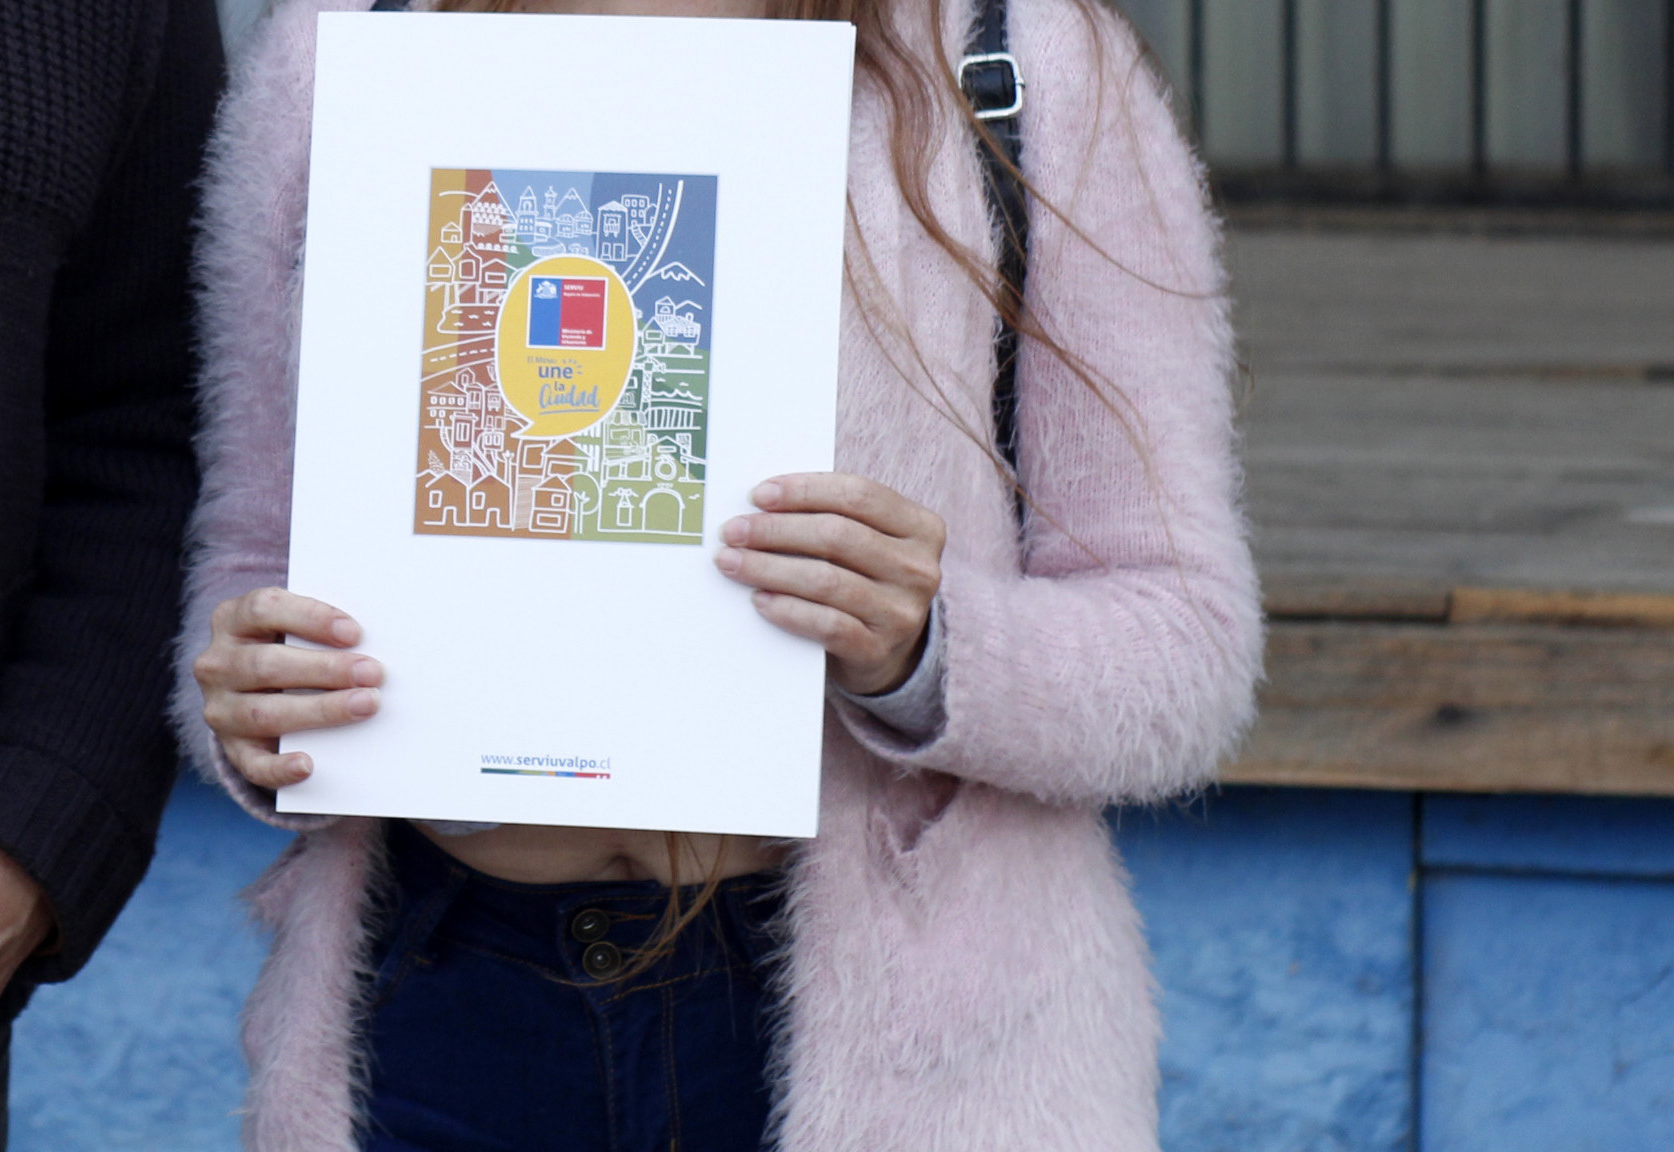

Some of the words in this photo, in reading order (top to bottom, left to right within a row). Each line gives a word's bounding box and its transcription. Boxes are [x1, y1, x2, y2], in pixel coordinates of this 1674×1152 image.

[538, 366, 573, 379] une
[554, 381, 565, 391] la
[538, 383, 601, 409] Ciudad
[481, 754, 611, 771] www.serviuvalpo.cl
